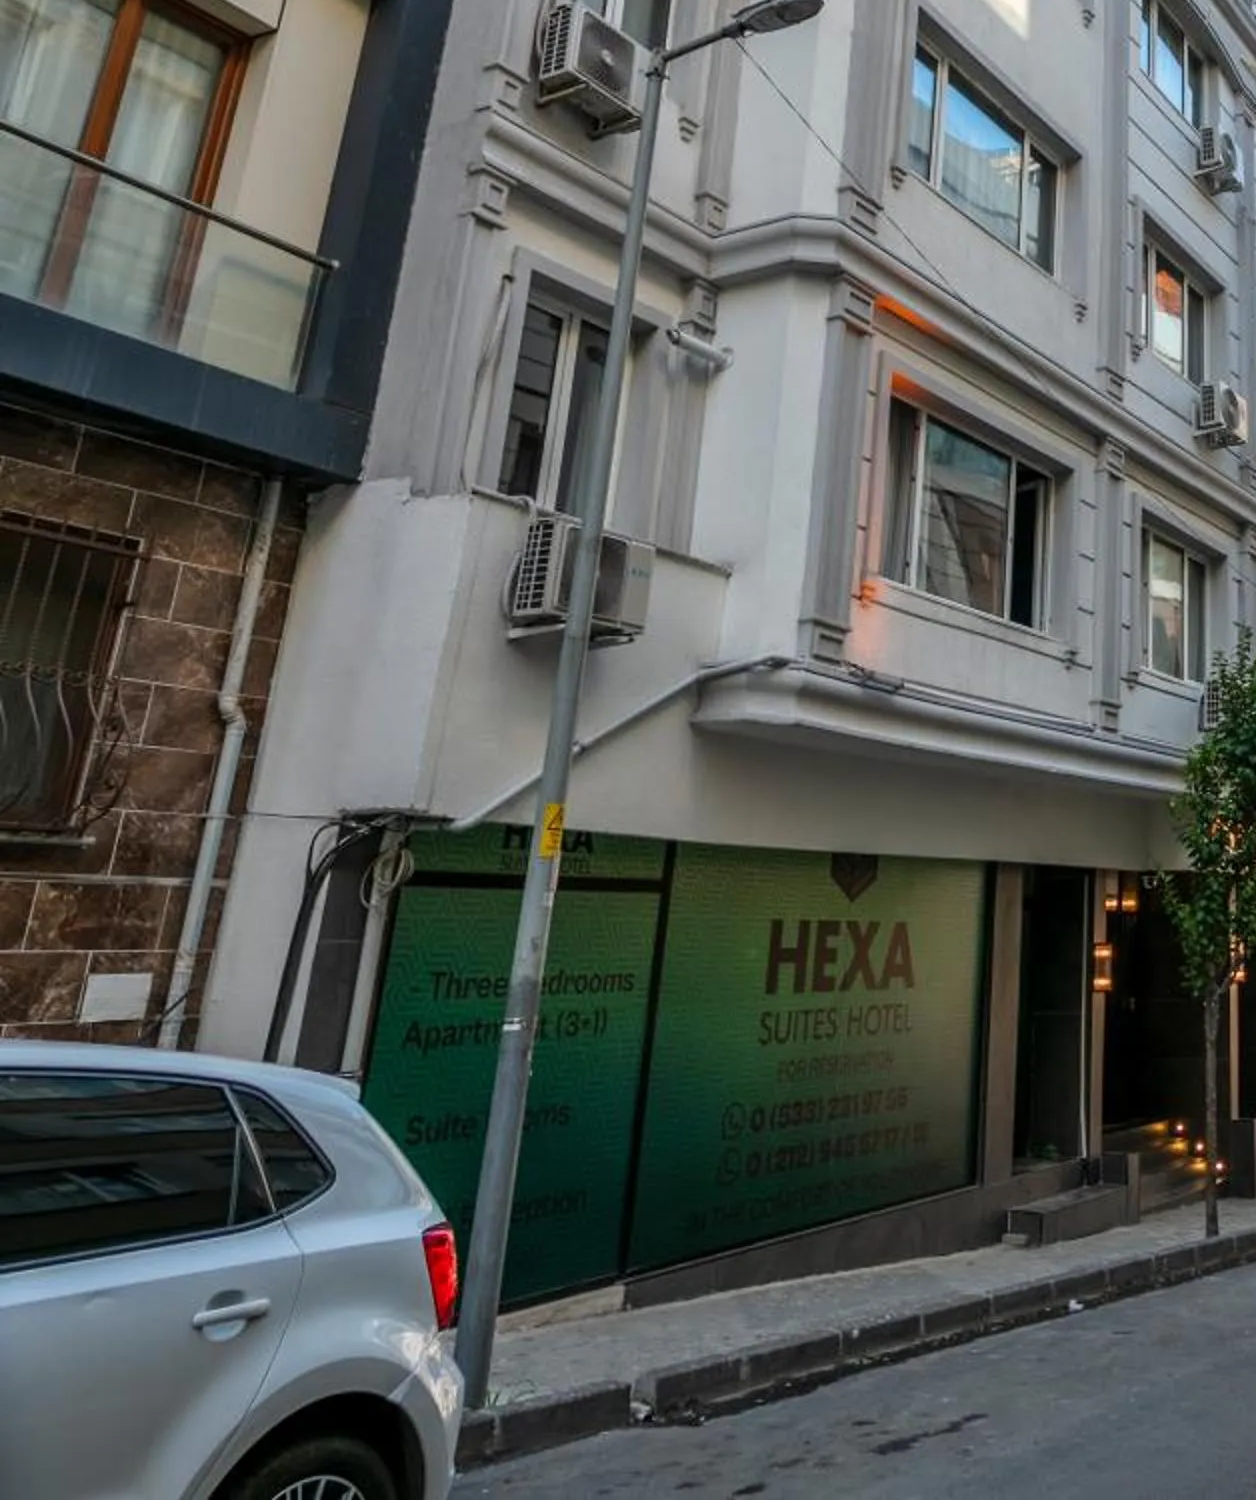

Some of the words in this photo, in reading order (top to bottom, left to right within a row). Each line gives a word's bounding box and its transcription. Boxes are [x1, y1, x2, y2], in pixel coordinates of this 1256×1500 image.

[765, 918, 915, 996] HEXA
[430, 971, 509, 1002] Three
[541, 969, 635, 997] edrooms
[555, 1007, 608, 1040] (3+1)
[757, 1007, 838, 1047] SUITES
[846, 1002, 913, 1037] HOTEL
[404, 1111, 478, 1148] Suite
